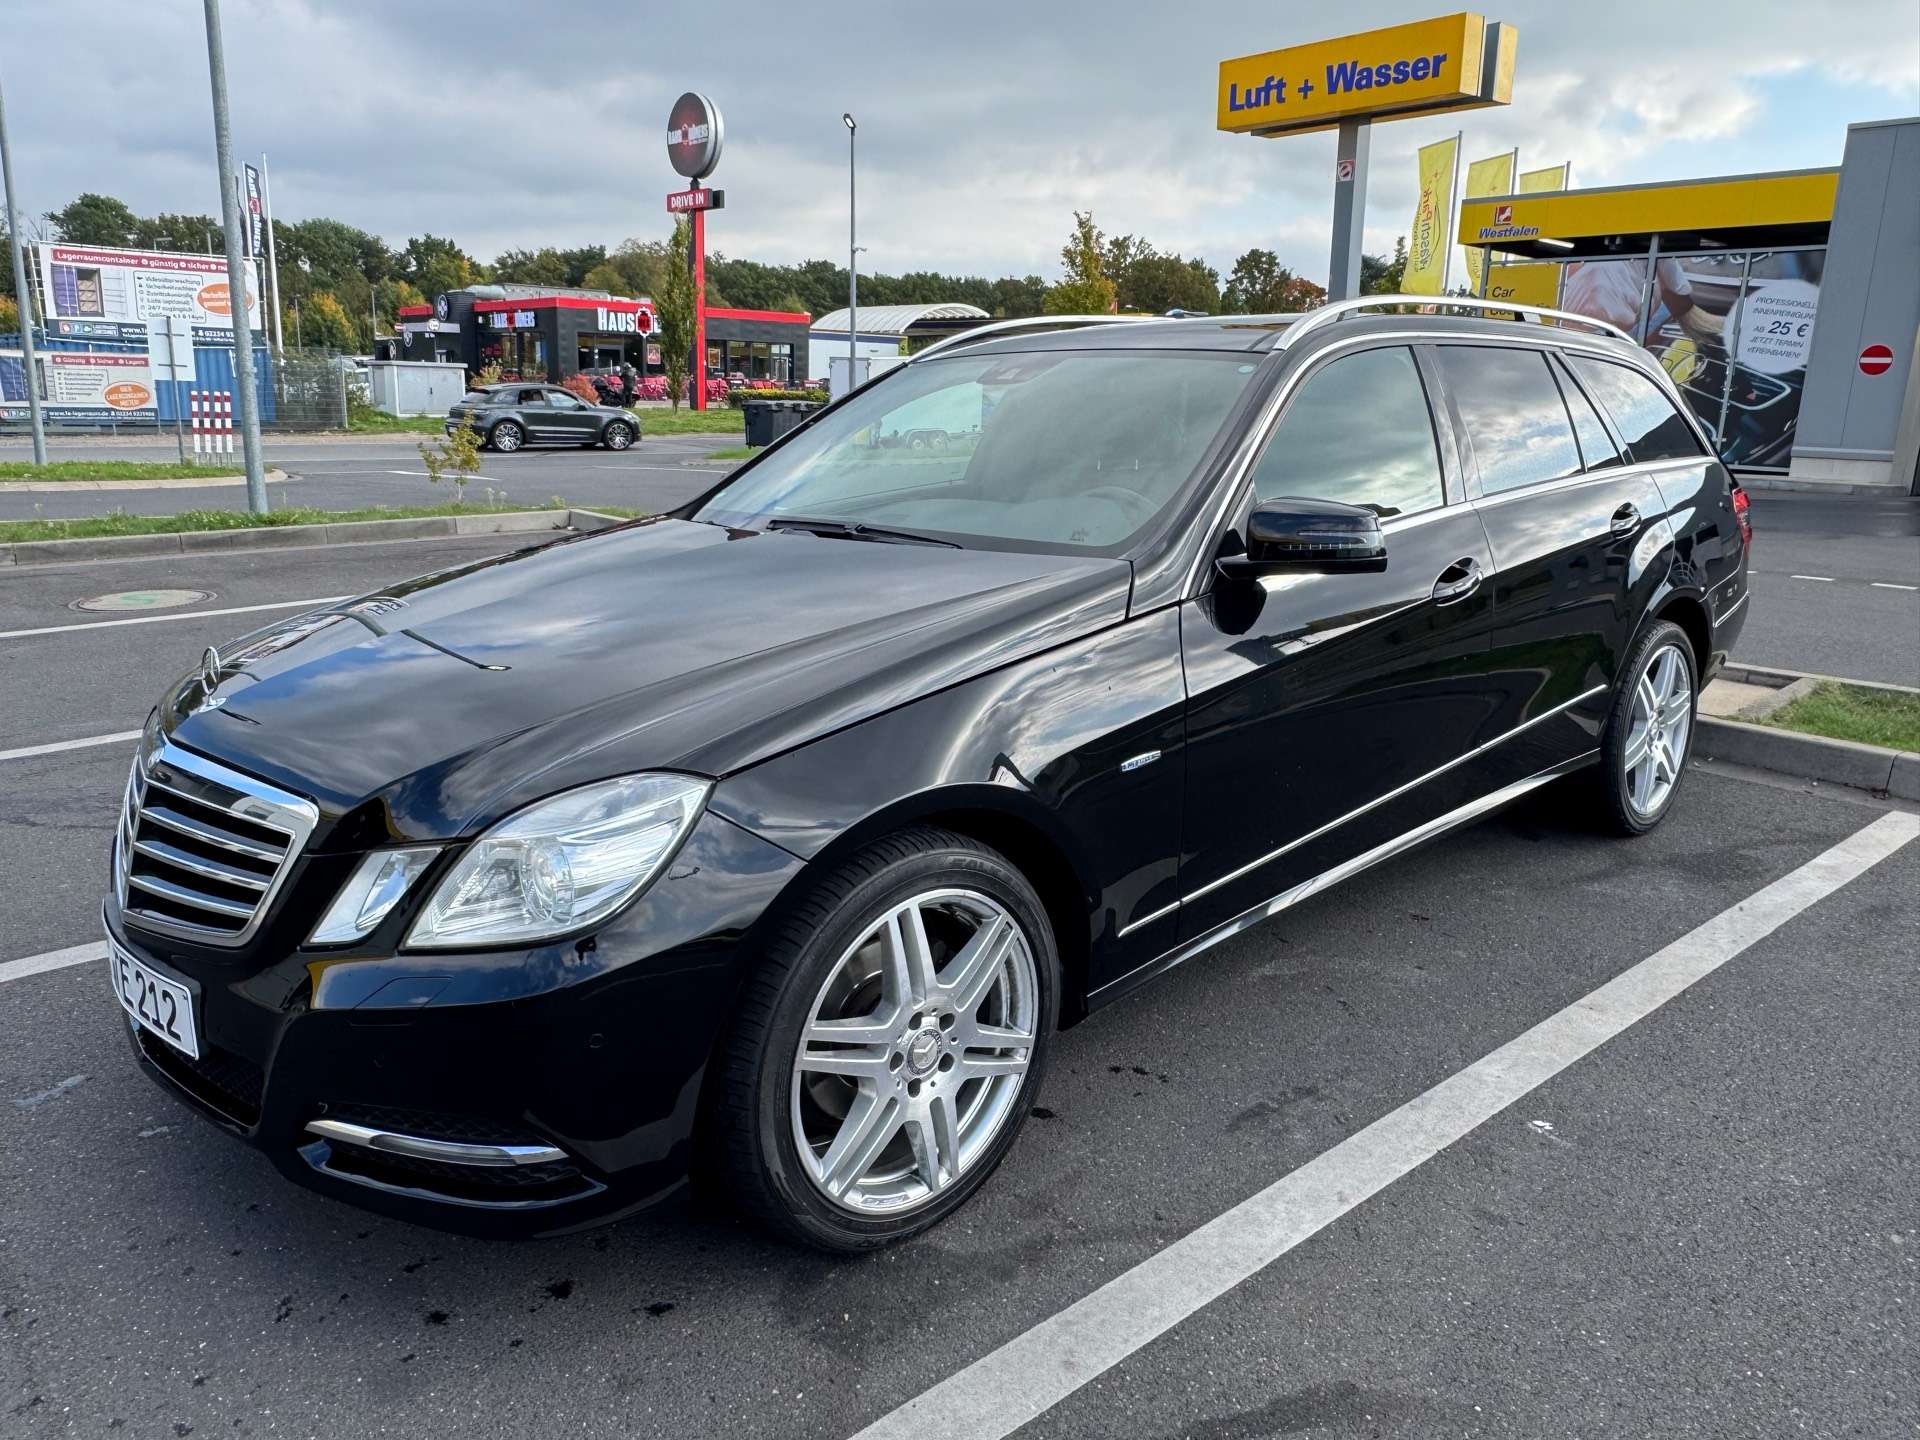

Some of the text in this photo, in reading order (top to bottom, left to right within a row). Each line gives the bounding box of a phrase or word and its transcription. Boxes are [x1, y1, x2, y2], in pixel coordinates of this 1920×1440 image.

[1229, 53, 1447, 112] Luft + Wasser
[671, 192, 704, 208] DRIVE IN
[1479, 226, 1539, 239] Westfalen
[57, 251, 139, 265] Lagerraumcontainer
[149, 259, 179, 269] günstig
[187, 261, 209, 270] sicher
[1491, 286, 1515, 298] Car
[1755, 296, 1816, 309] PROFESSIONELL
[597, 308, 634, 331] HAUS
[1753, 308, 1815, 320] INNENREINIGUN
[1768, 320, 1793, 335] 25
[1796, 323, 1809, 338] €
[136, 970, 182, 1042] 212
